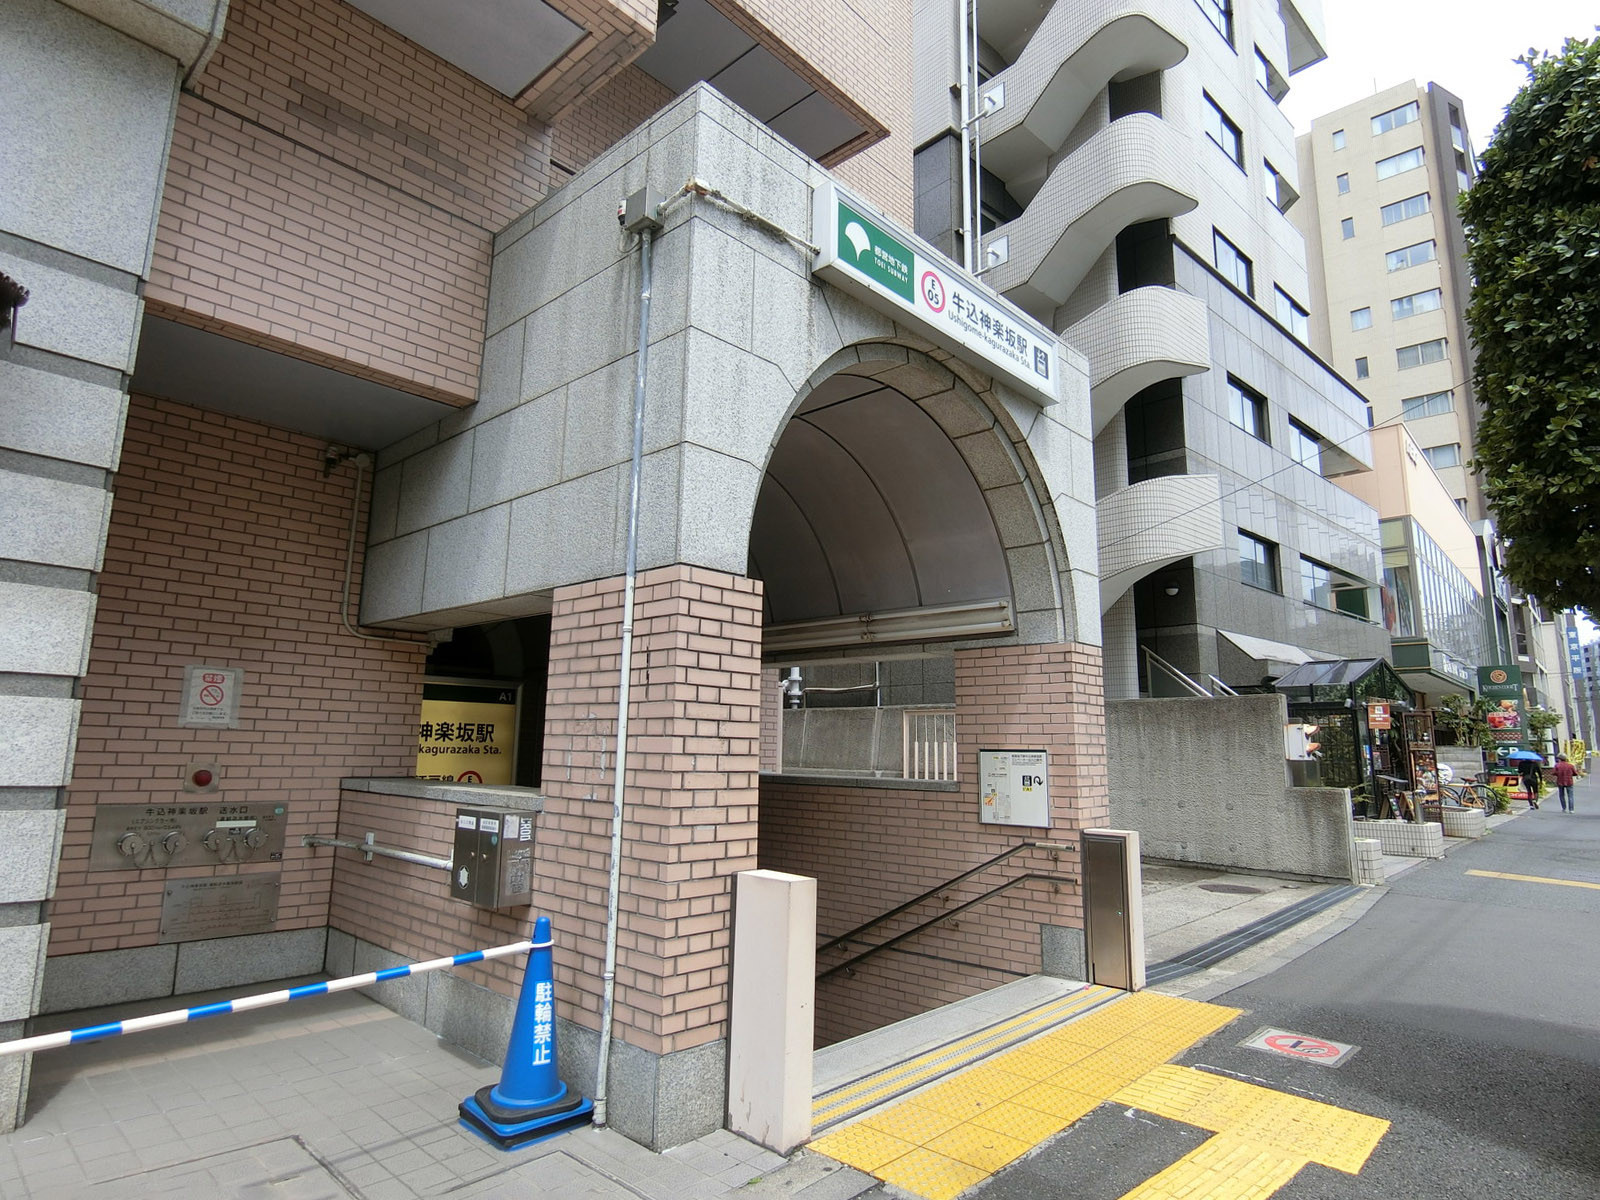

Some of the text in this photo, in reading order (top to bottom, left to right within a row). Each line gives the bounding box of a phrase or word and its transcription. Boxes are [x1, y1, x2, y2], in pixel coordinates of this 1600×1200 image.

[874, 257, 908, 284] TOEI SUBWAY
[931, 279, 936, 290] E
[927, 289, 939, 305] 05
[952, 291, 1028, 357] 牛込神楽坂駅
[498, 692, 512, 701] A1
[483, 745, 502, 755] Sta.
[145, 806, 209, 816] 牛込神楽坂駅
[532, 981, 552, 1067] 駐輪禁止
